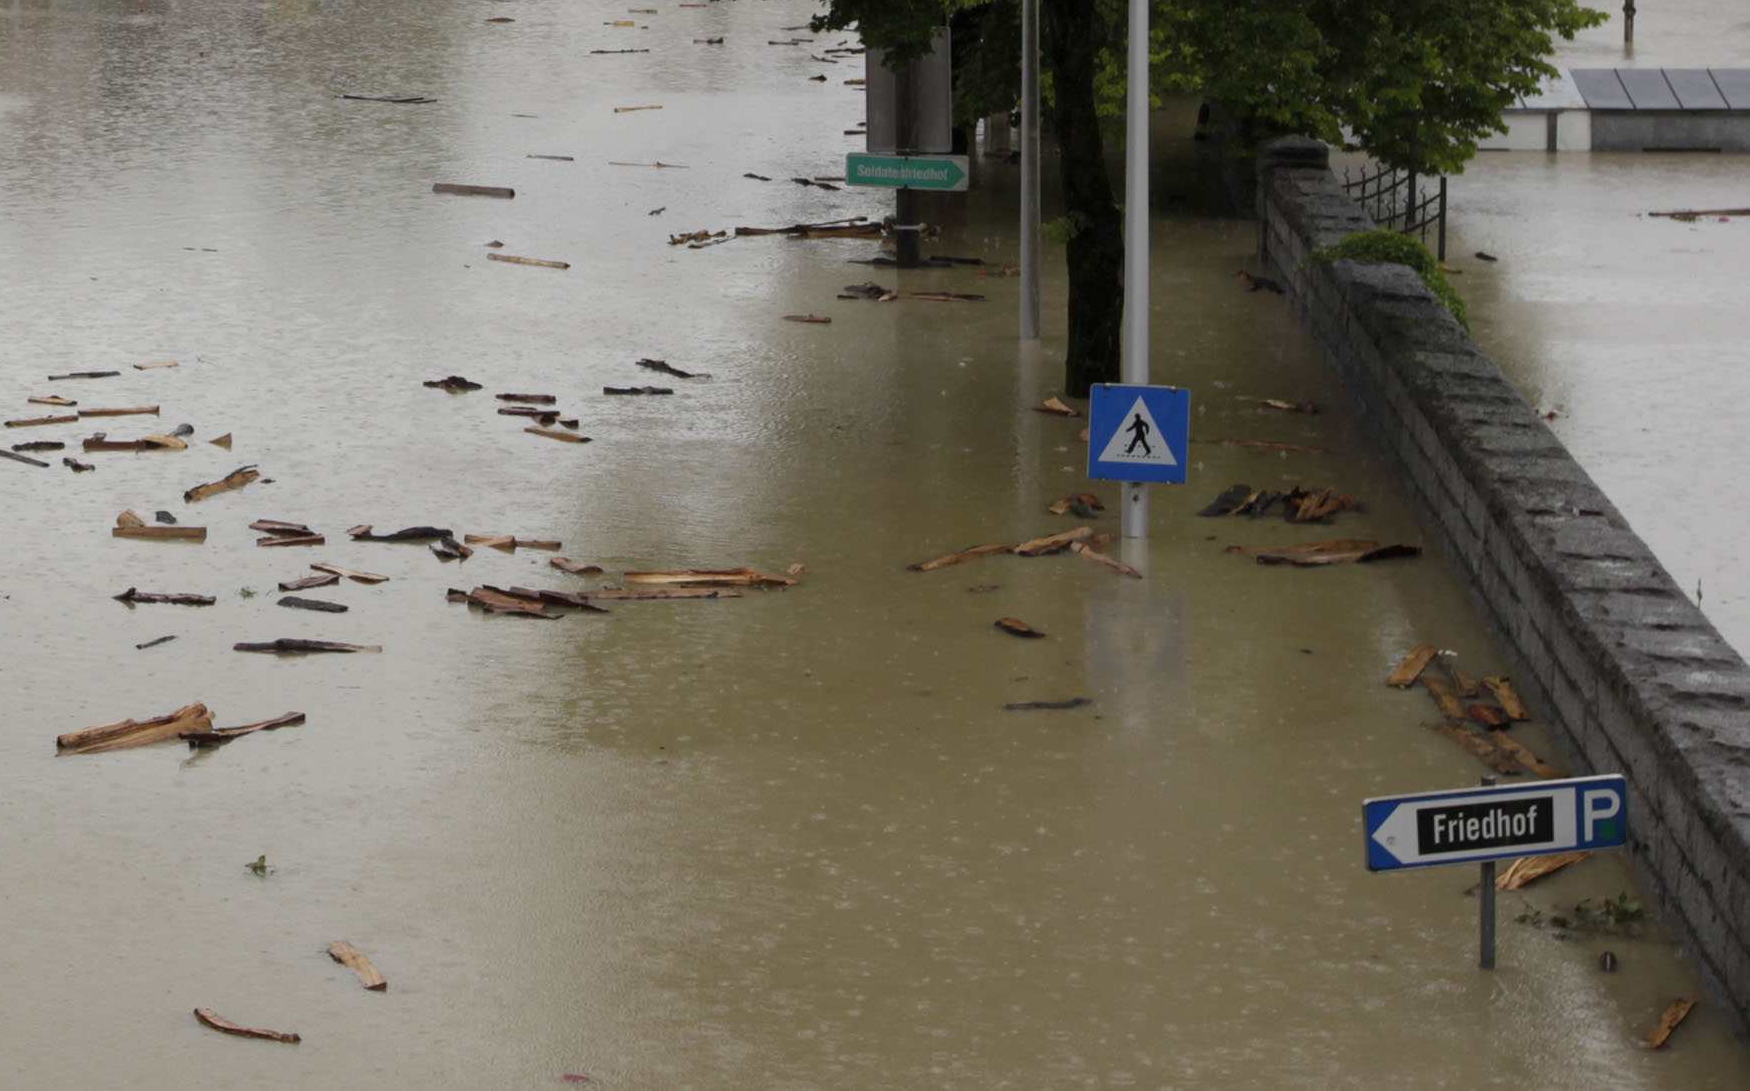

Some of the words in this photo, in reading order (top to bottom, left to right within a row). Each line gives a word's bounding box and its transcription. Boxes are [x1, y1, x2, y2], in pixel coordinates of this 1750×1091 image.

[857, 164, 948, 181] Soldatenfriedhof
[1432, 804, 1538, 845] Friedhof
[1583, 788, 1621, 843] P
